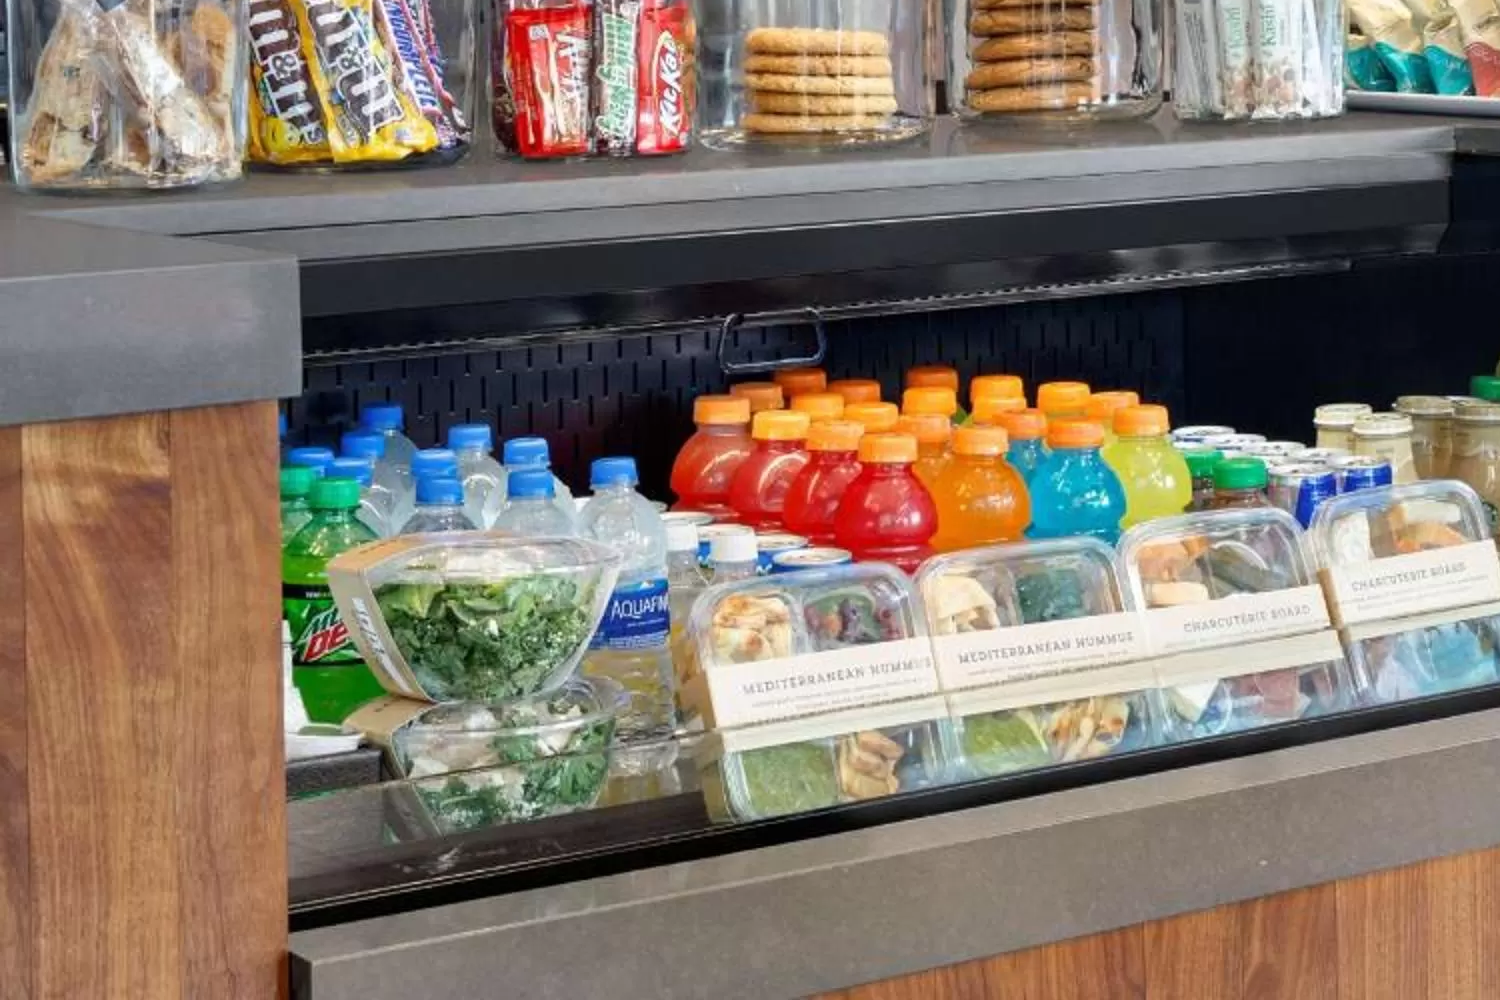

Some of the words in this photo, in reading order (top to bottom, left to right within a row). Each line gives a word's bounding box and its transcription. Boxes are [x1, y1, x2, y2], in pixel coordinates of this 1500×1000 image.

[1430, 562, 1467, 578] BOARD
[1183, 610, 1268, 634] CHARCUTERIE
[1270, 603, 1311, 620] BOARD
[958, 639, 1072, 665] MEDITERRANEAN
[1075, 631, 1134, 649] HUMMUS
[742, 665, 865, 696] MEDITERRANEAN
[868, 655, 932, 677] HUMMUS
